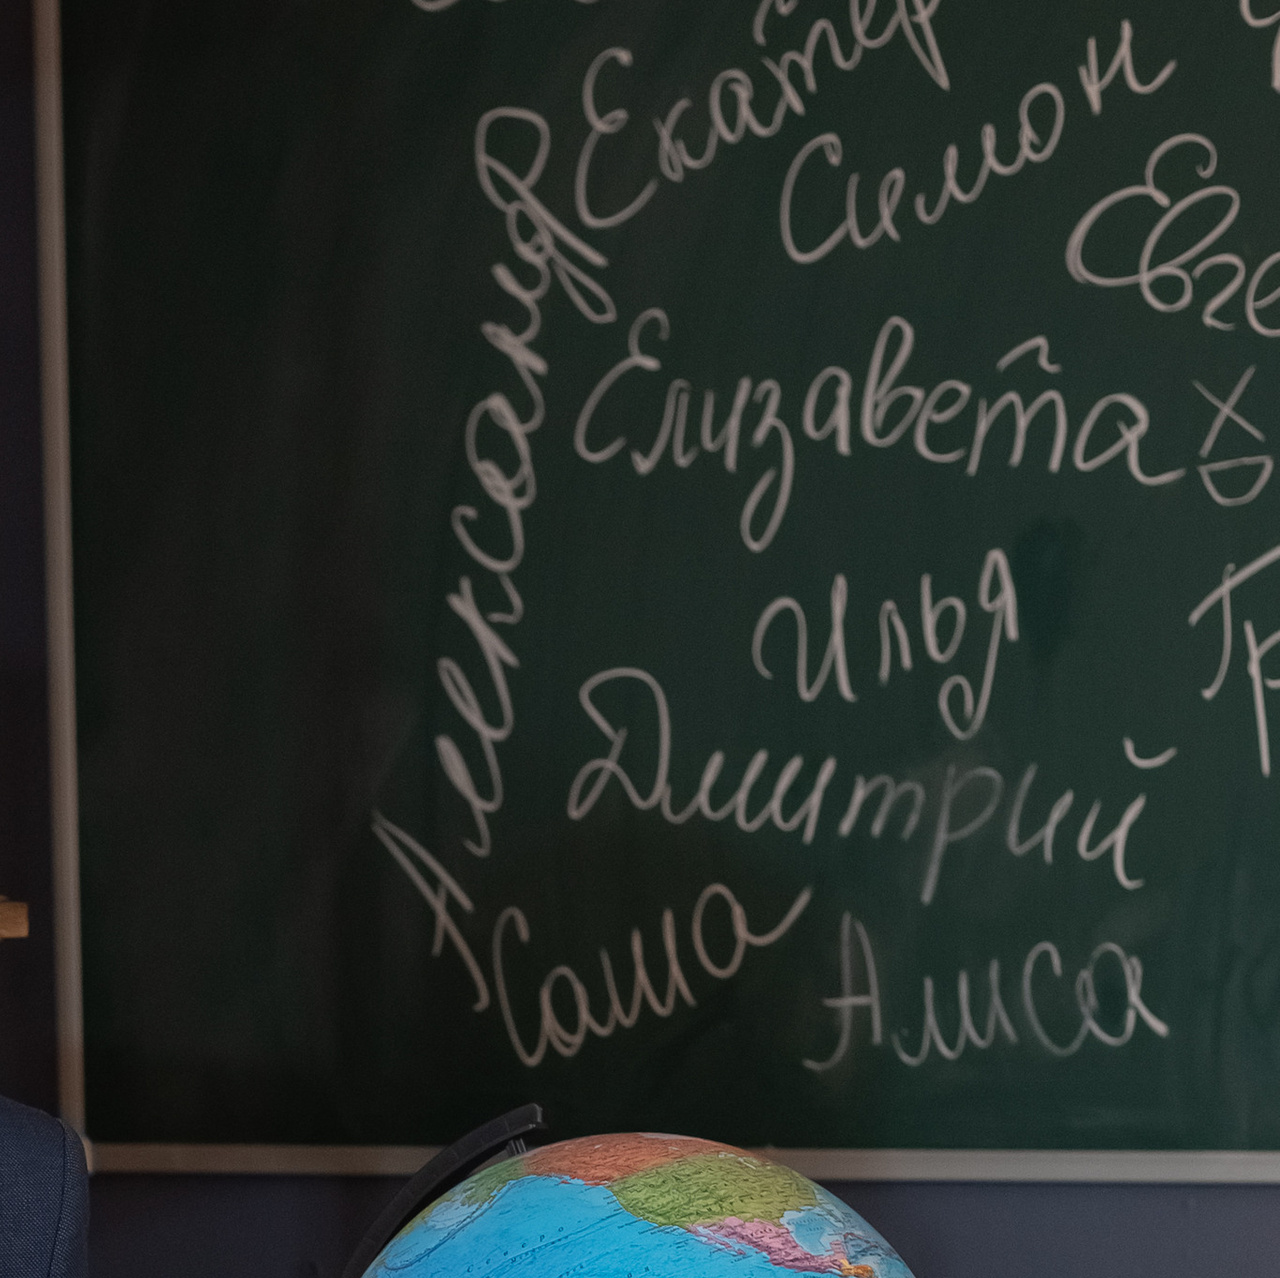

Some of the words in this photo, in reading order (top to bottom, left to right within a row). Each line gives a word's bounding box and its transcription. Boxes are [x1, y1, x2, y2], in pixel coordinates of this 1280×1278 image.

[779, 18, 1179, 265] Симон
[573, 306, 1188, 555] Елизавета
[371, 105, 618, 1012] Александр
[751, 547, 1020, 741] Илья
[566, 666, 1179, 906] Дмитрий
[492, 882, 812, 1068] Саша
[802, 911, 1172, 1074] Алиса
